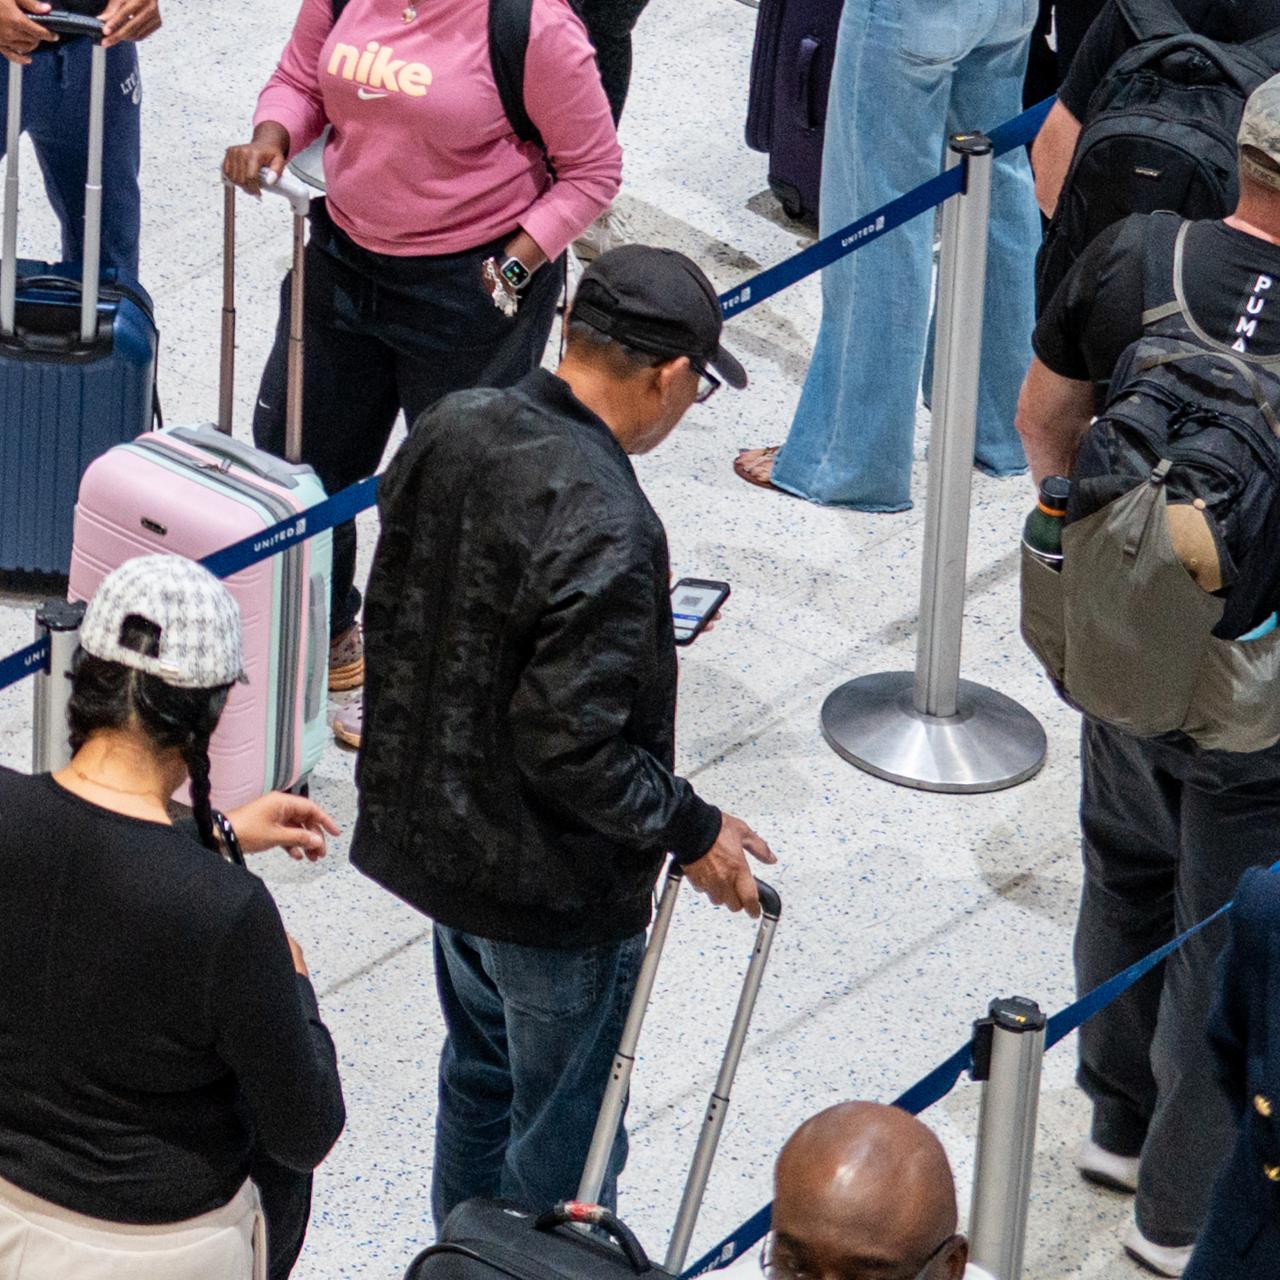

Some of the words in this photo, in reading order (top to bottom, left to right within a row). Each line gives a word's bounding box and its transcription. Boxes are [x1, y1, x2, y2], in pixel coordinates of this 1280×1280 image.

[327, 41, 433, 97] nike
[841, 225, 875, 247] UNITED
[1231, 274, 1272, 353] PUMA
[253, 528, 295, 552] UNITED
